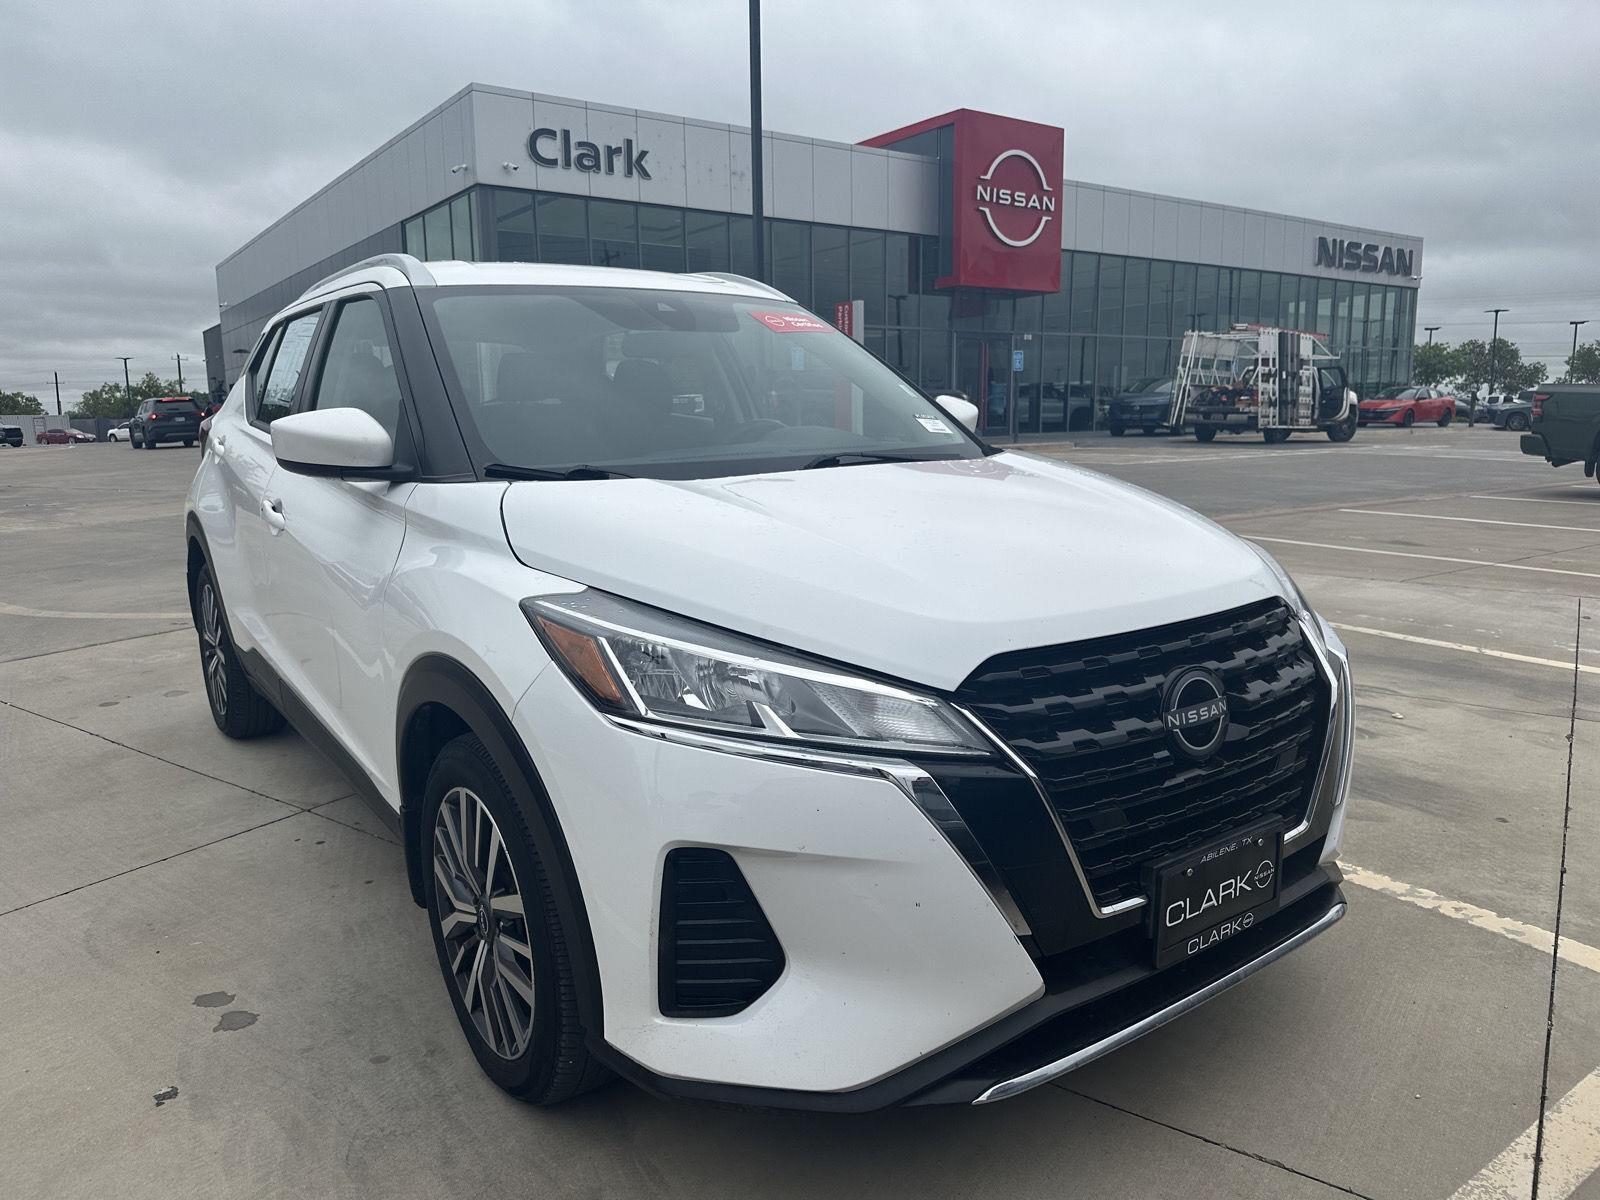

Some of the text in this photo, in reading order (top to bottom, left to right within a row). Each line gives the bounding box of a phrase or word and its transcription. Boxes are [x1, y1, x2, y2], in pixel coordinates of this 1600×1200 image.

[527, 127, 652, 180] Clark
[976, 184, 1055, 212] NISSAN
[1314, 236, 1413, 277] NISSAN
[1167, 699, 1227, 728] NISSAN
[1241, 836, 1253, 847] TX
[1166, 869, 1252, 927] CLARK
[1187, 917, 1242, 955] CLARK
